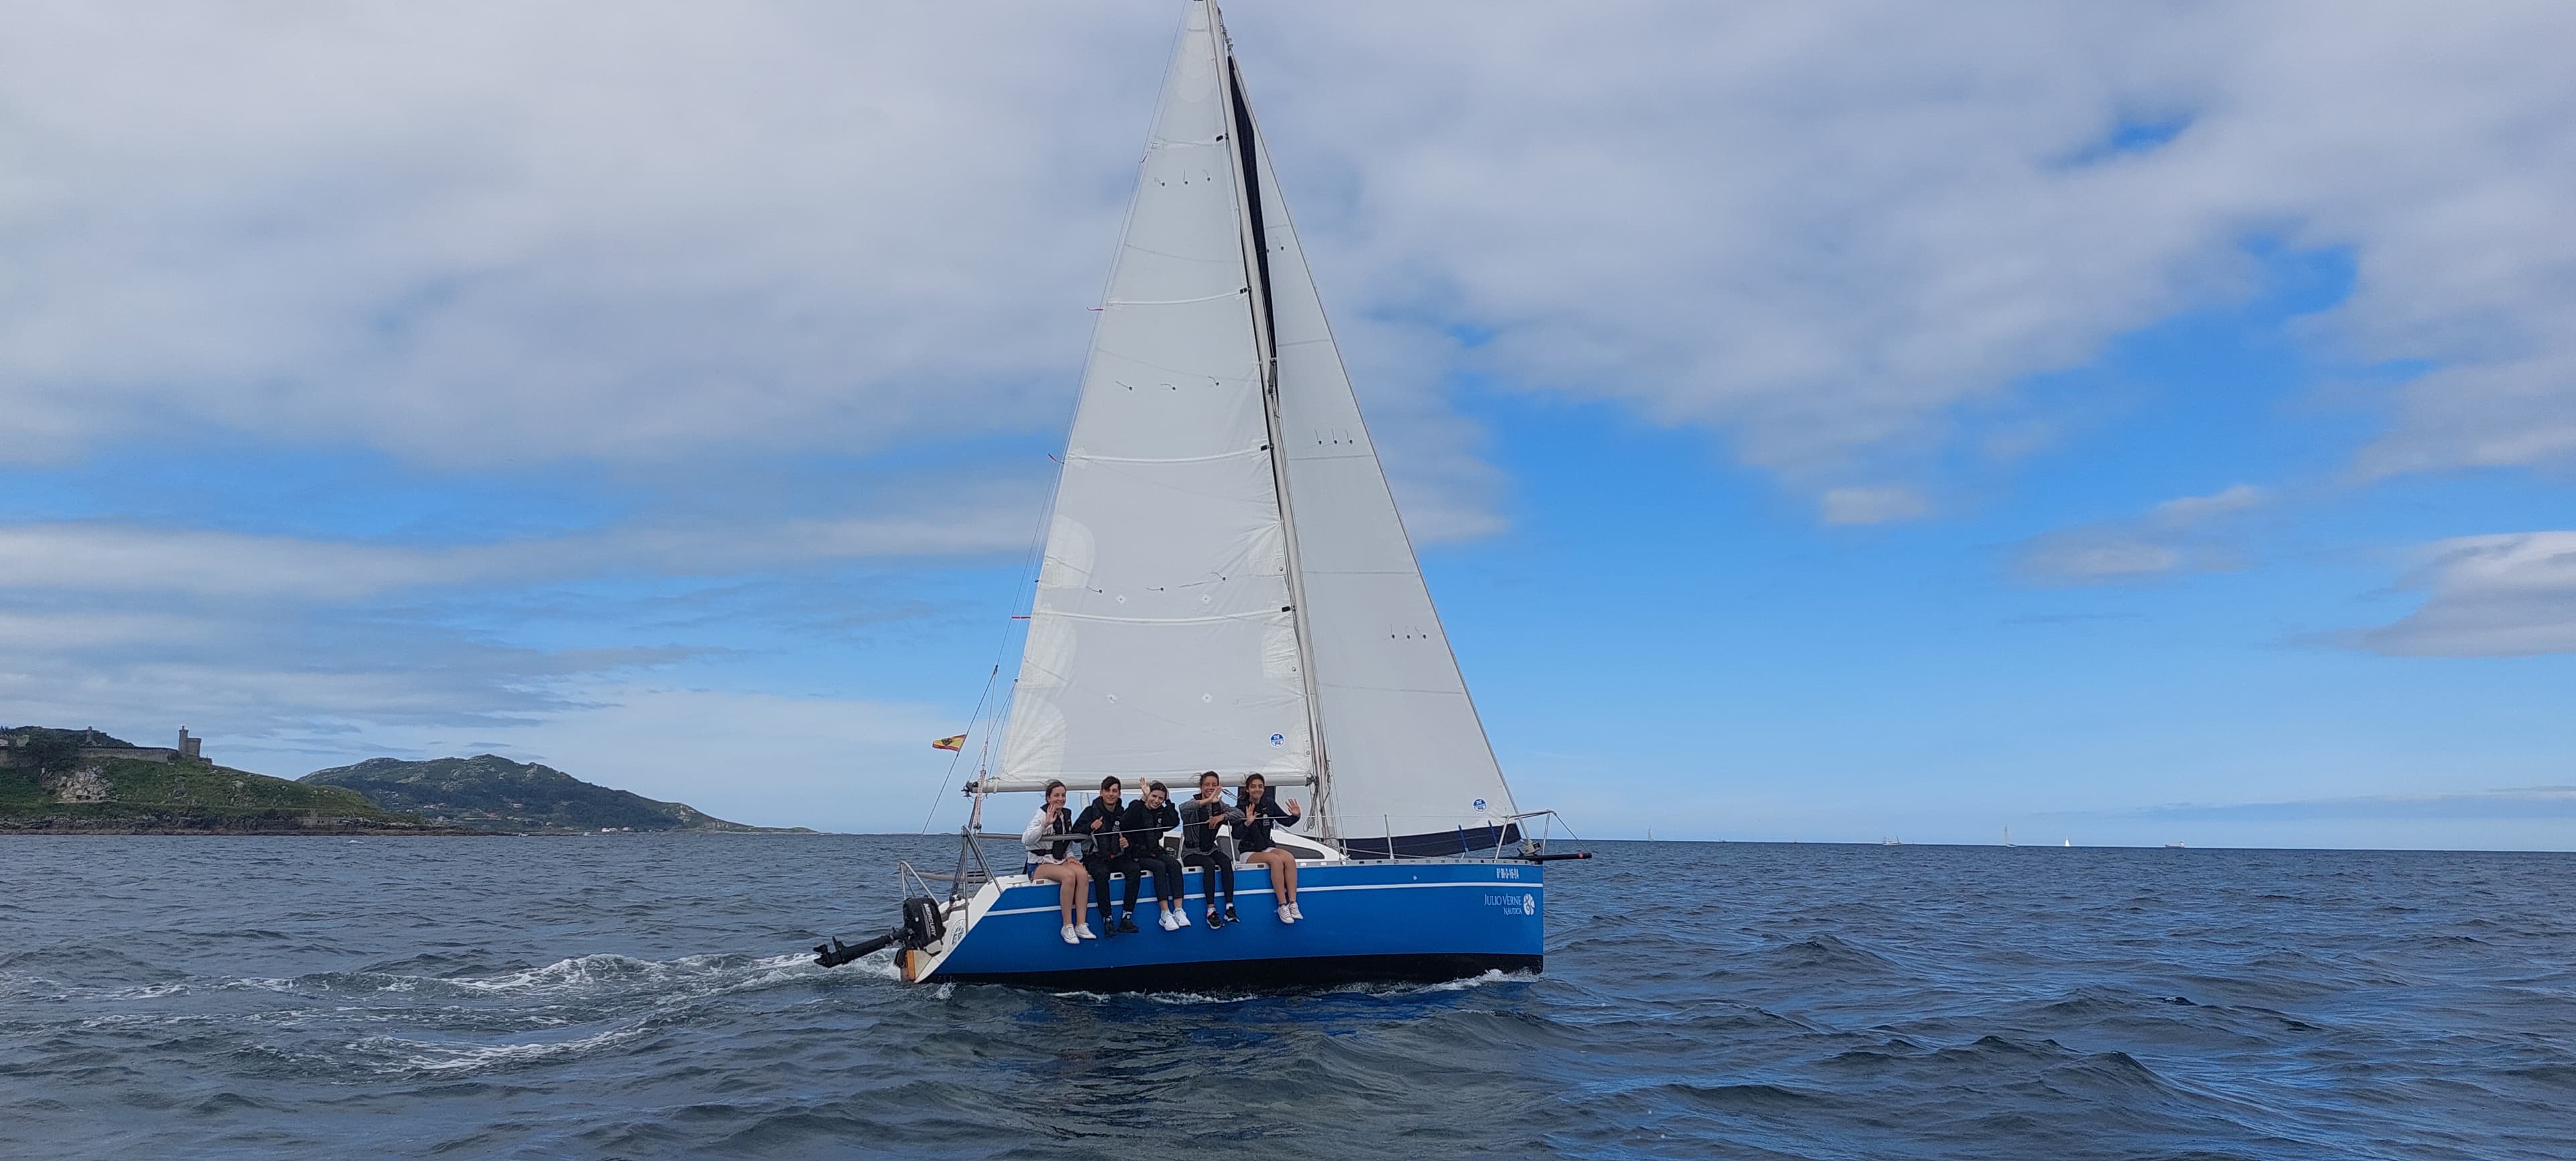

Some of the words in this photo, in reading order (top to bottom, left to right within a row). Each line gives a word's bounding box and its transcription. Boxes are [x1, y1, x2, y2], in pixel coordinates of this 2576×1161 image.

[1484, 893, 1502, 905] JULIO
[1502, 893, 1522, 905] VERNE
[923, 903, 937, 937] MERCURY
